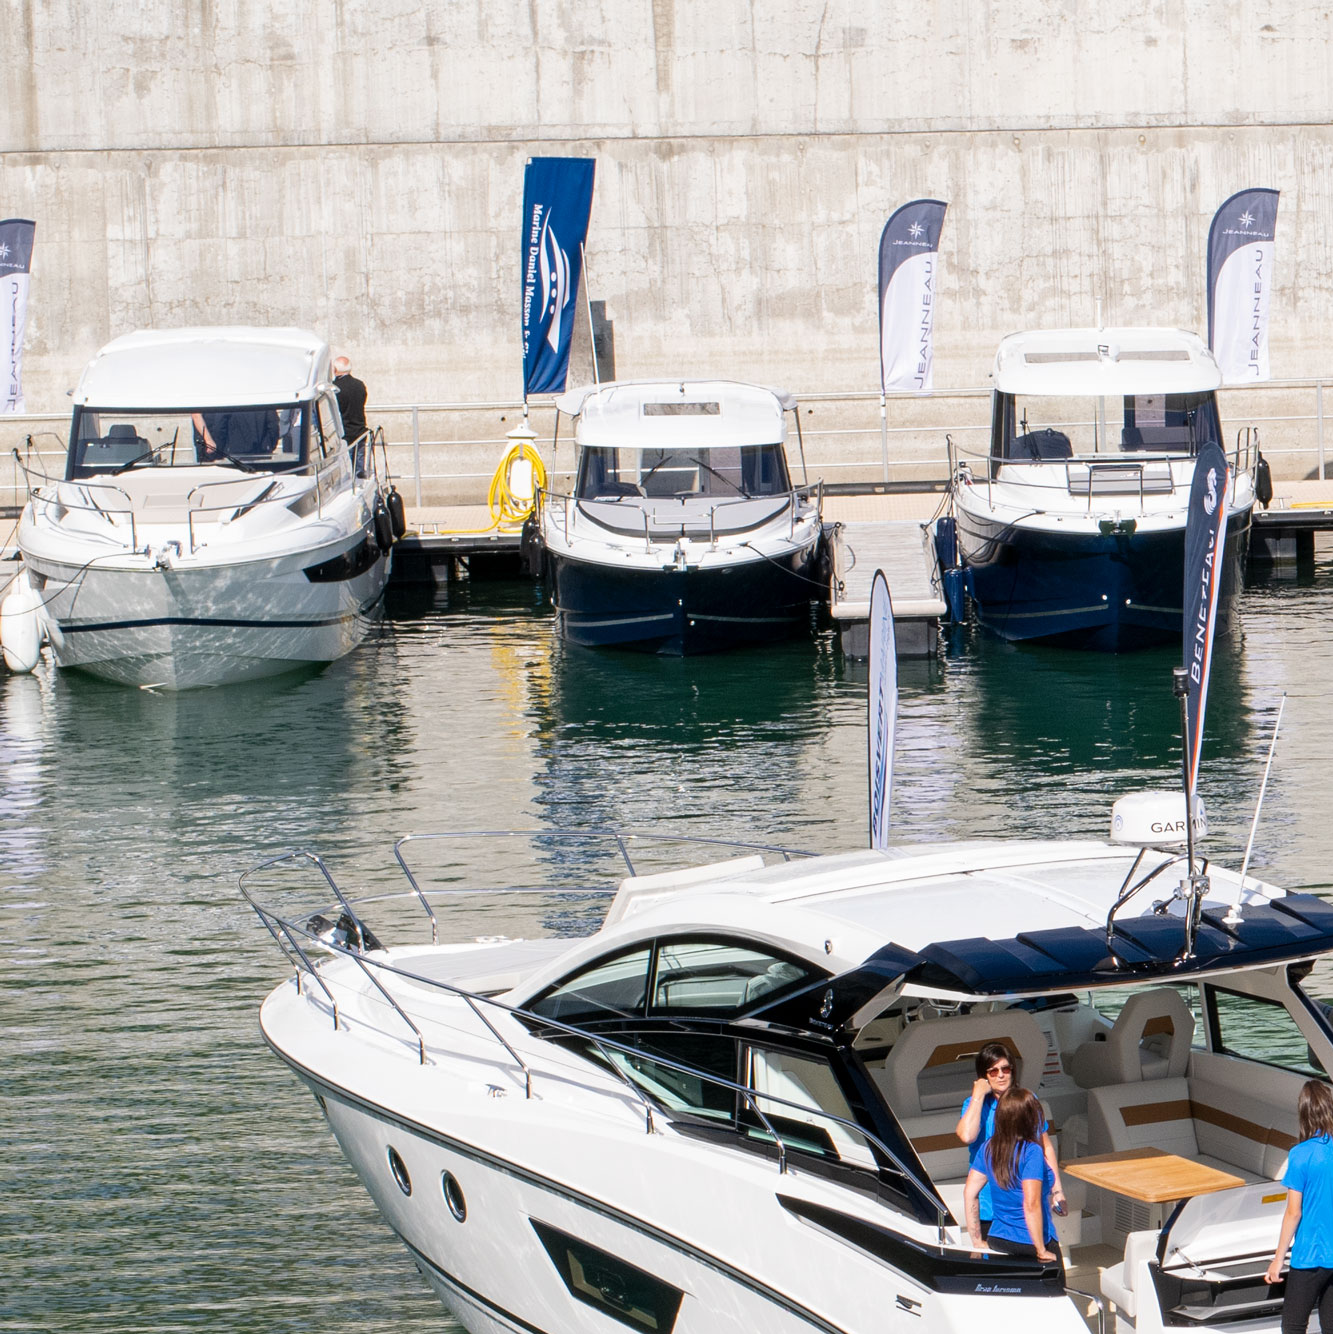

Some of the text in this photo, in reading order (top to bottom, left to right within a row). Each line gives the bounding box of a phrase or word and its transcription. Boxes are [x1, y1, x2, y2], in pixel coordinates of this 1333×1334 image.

[530, 203, 544, 244] Marine
[1222, 228, 1270, 238] JEANNEAU
[526, 246, 540, 283] Daniel
[522, 285, 536, 327] Masson
[913, 261, 933, 390] JEANNEAU
[1247, 249, 1264, 377] JEANNEAU
